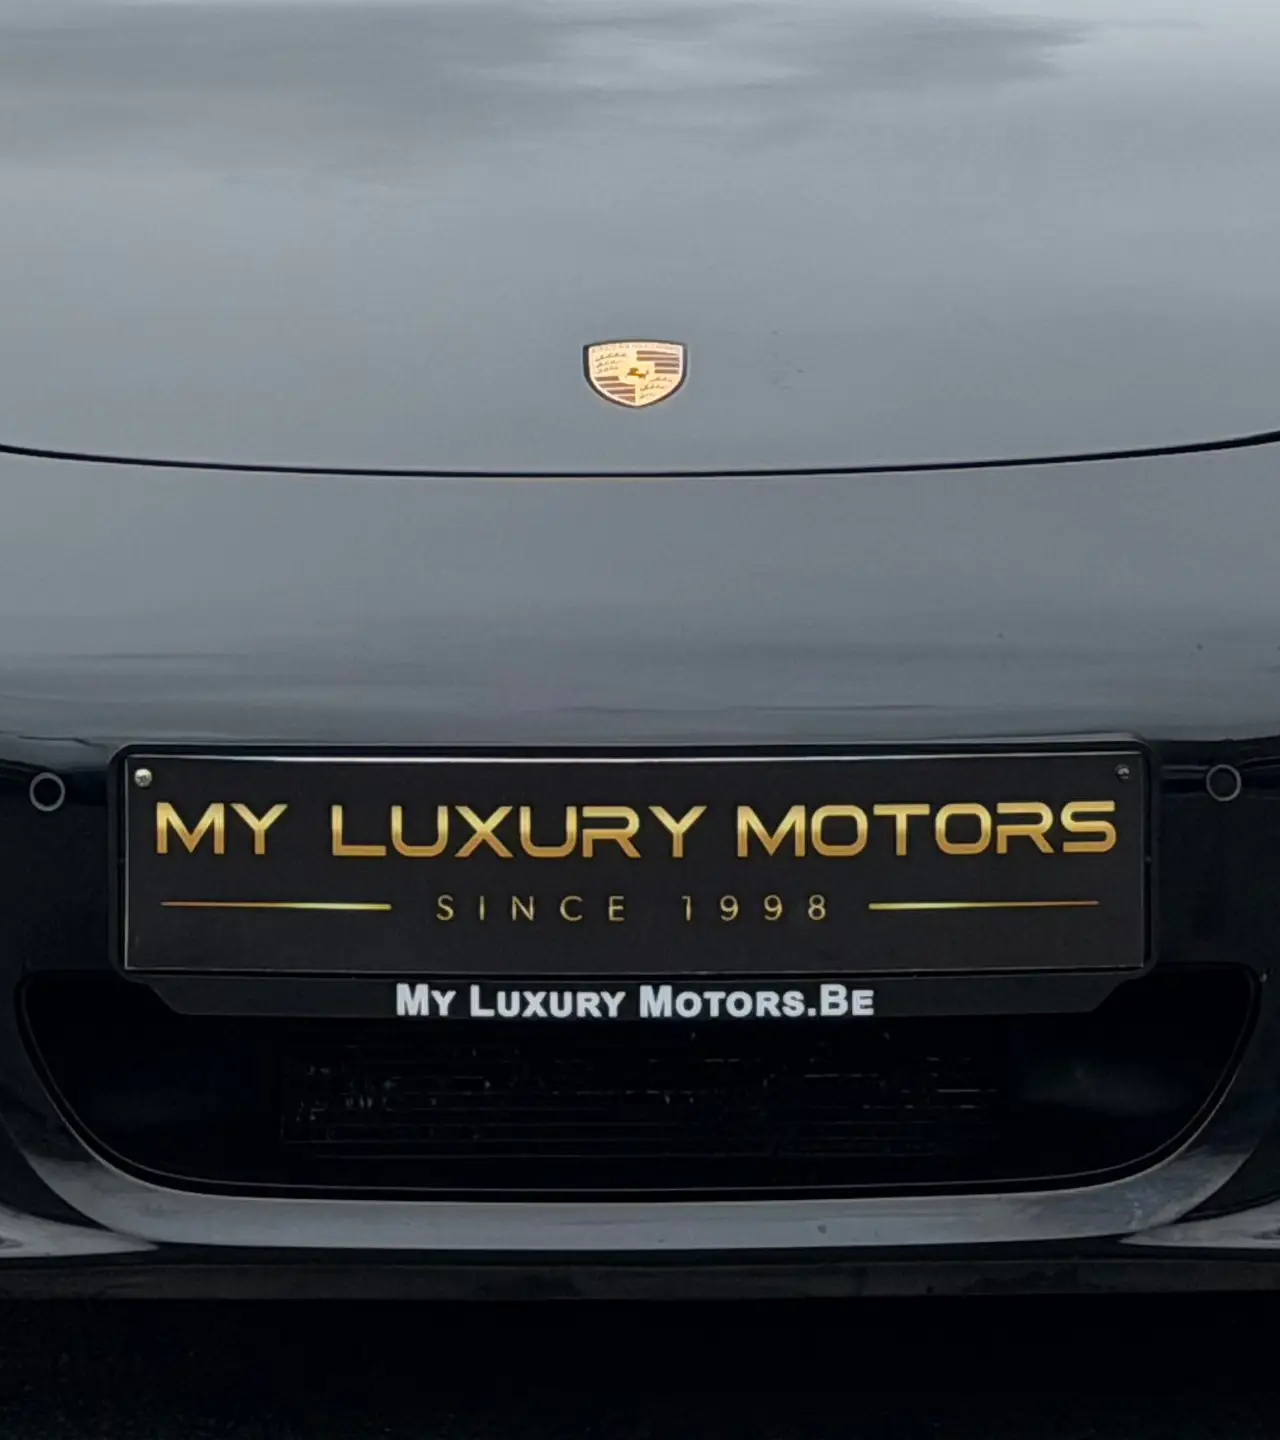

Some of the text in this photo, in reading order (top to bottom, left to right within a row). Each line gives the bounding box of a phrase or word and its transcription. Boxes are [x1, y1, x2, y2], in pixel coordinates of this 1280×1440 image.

[155, 800, 1117, 858] MY LUXURY MOTORS
[435, 893, 828, 922] SINCE 1998
